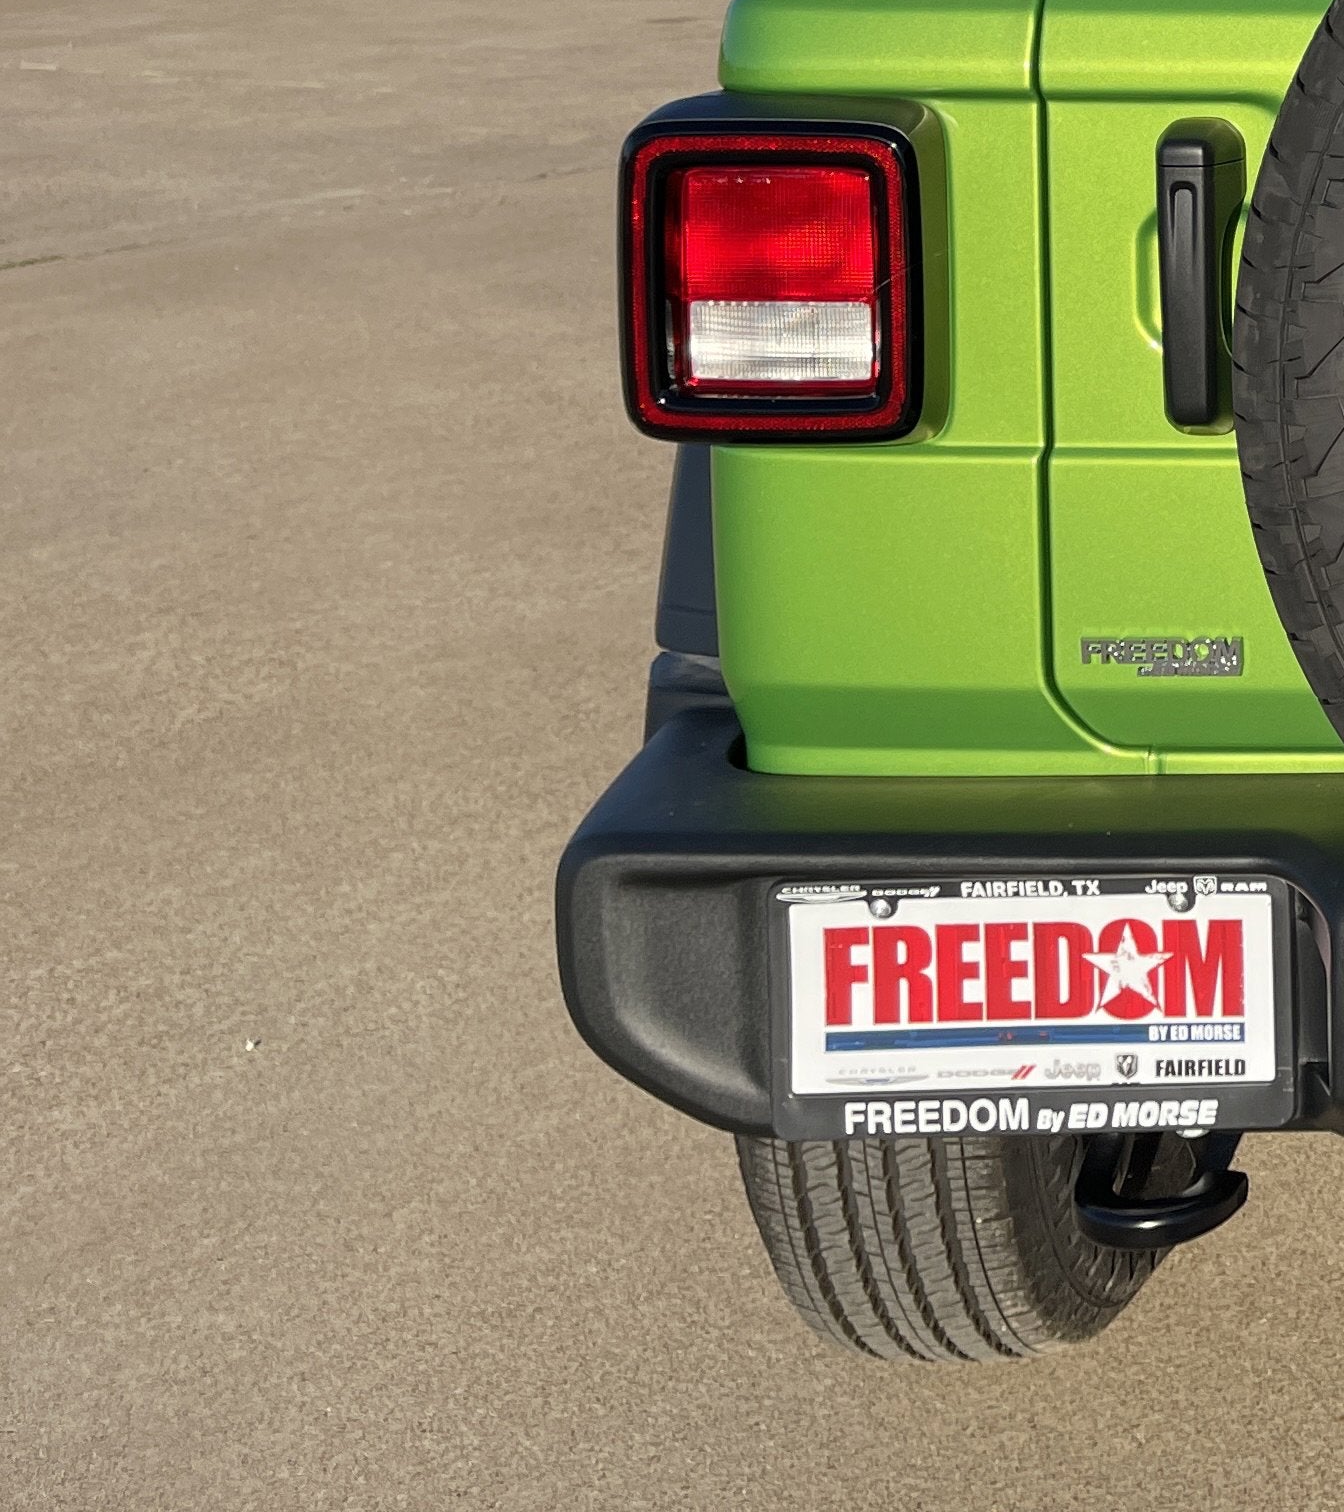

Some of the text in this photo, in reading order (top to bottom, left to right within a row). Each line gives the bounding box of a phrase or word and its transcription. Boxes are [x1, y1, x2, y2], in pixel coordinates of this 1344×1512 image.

[1081, 636, 1244, 665] FREEDOM
[960, 879, 1100, 898] FAIRFIELD, TX
[1145, 879, 1188, 895] Jeep
[1220, 881, 1267, 893] RAM
[822, 918, 1245, 1026] FREEDOM
[1148, 1023, 1241, 1041] BY ED MORSE
[1044, 1059, 1102, 1081] Jeep
[1155, 1058, 1246, 1078] FAIRFIELD
[844, 1097, 1219, 1135] FREEDOM By ED MORSE
